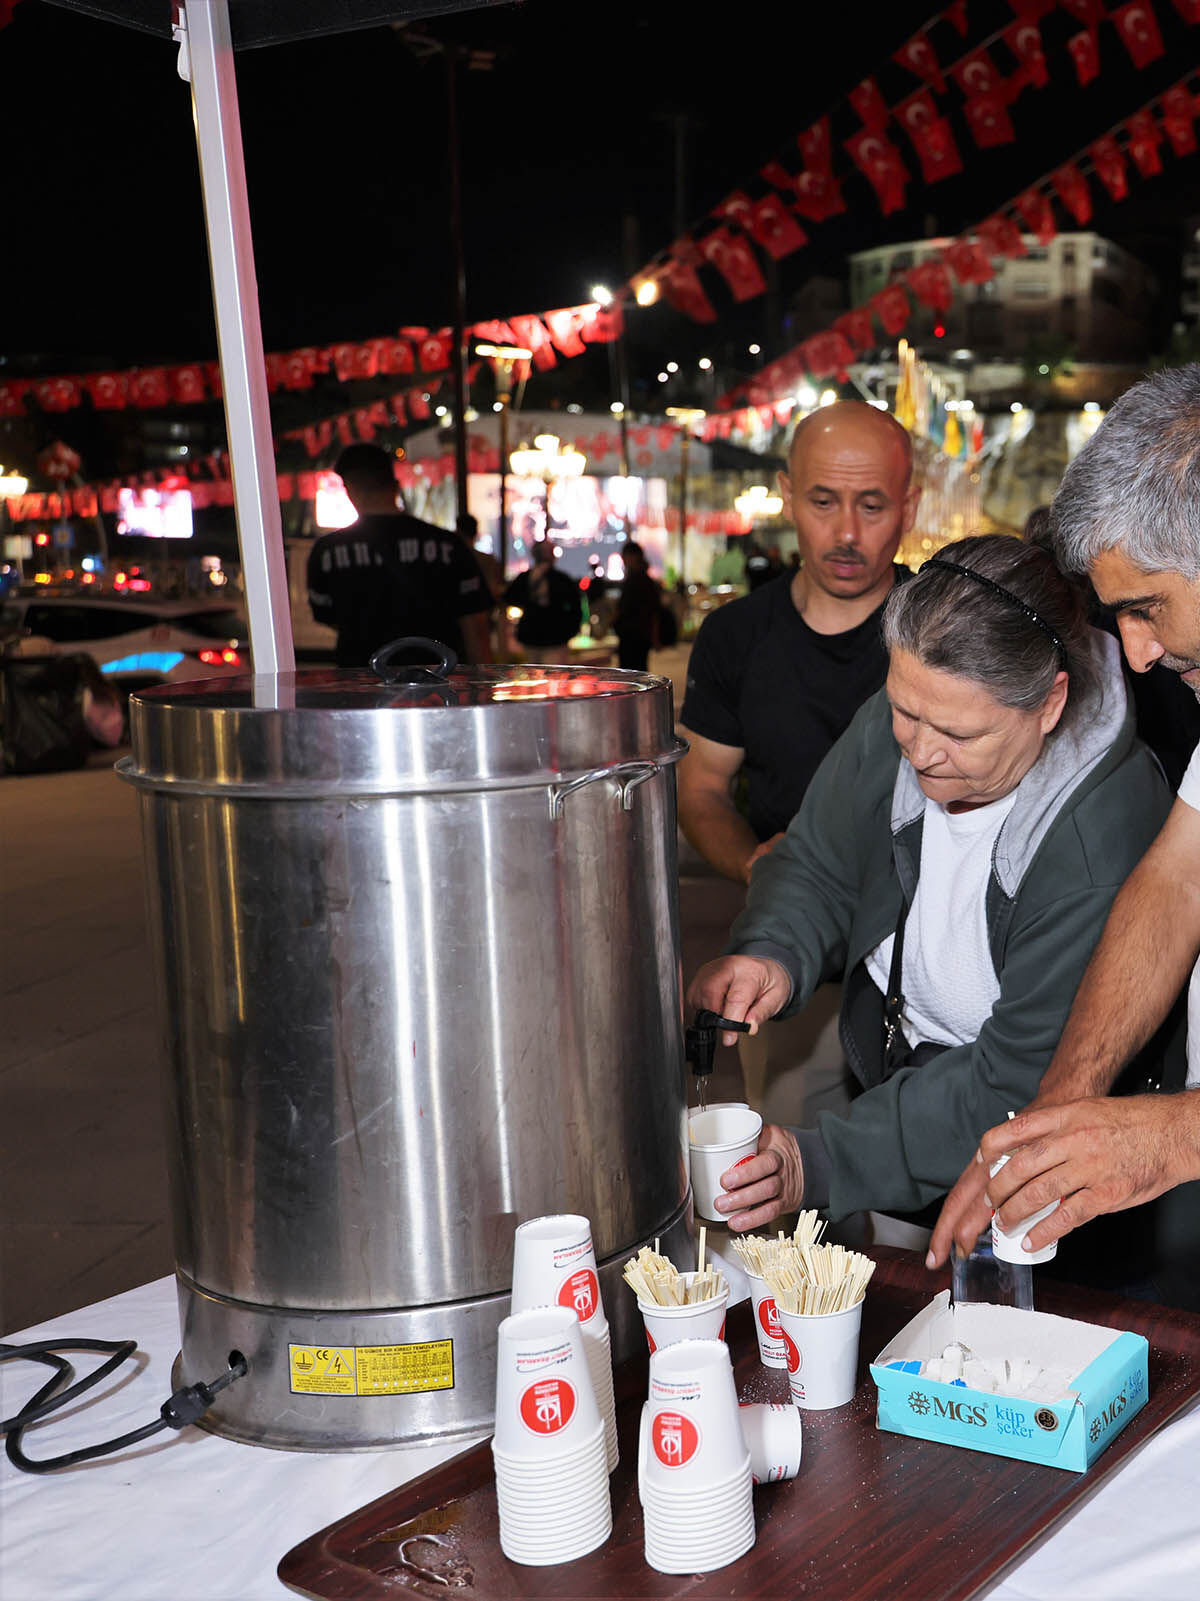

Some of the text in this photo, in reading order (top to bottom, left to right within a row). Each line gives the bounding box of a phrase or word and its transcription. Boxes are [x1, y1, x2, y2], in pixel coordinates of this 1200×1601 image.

[932, 1396, 988, 1428] MGS
[995, 1404, 1025, 1429] küp
[1101, 1388, 1127, 1432] MGS
